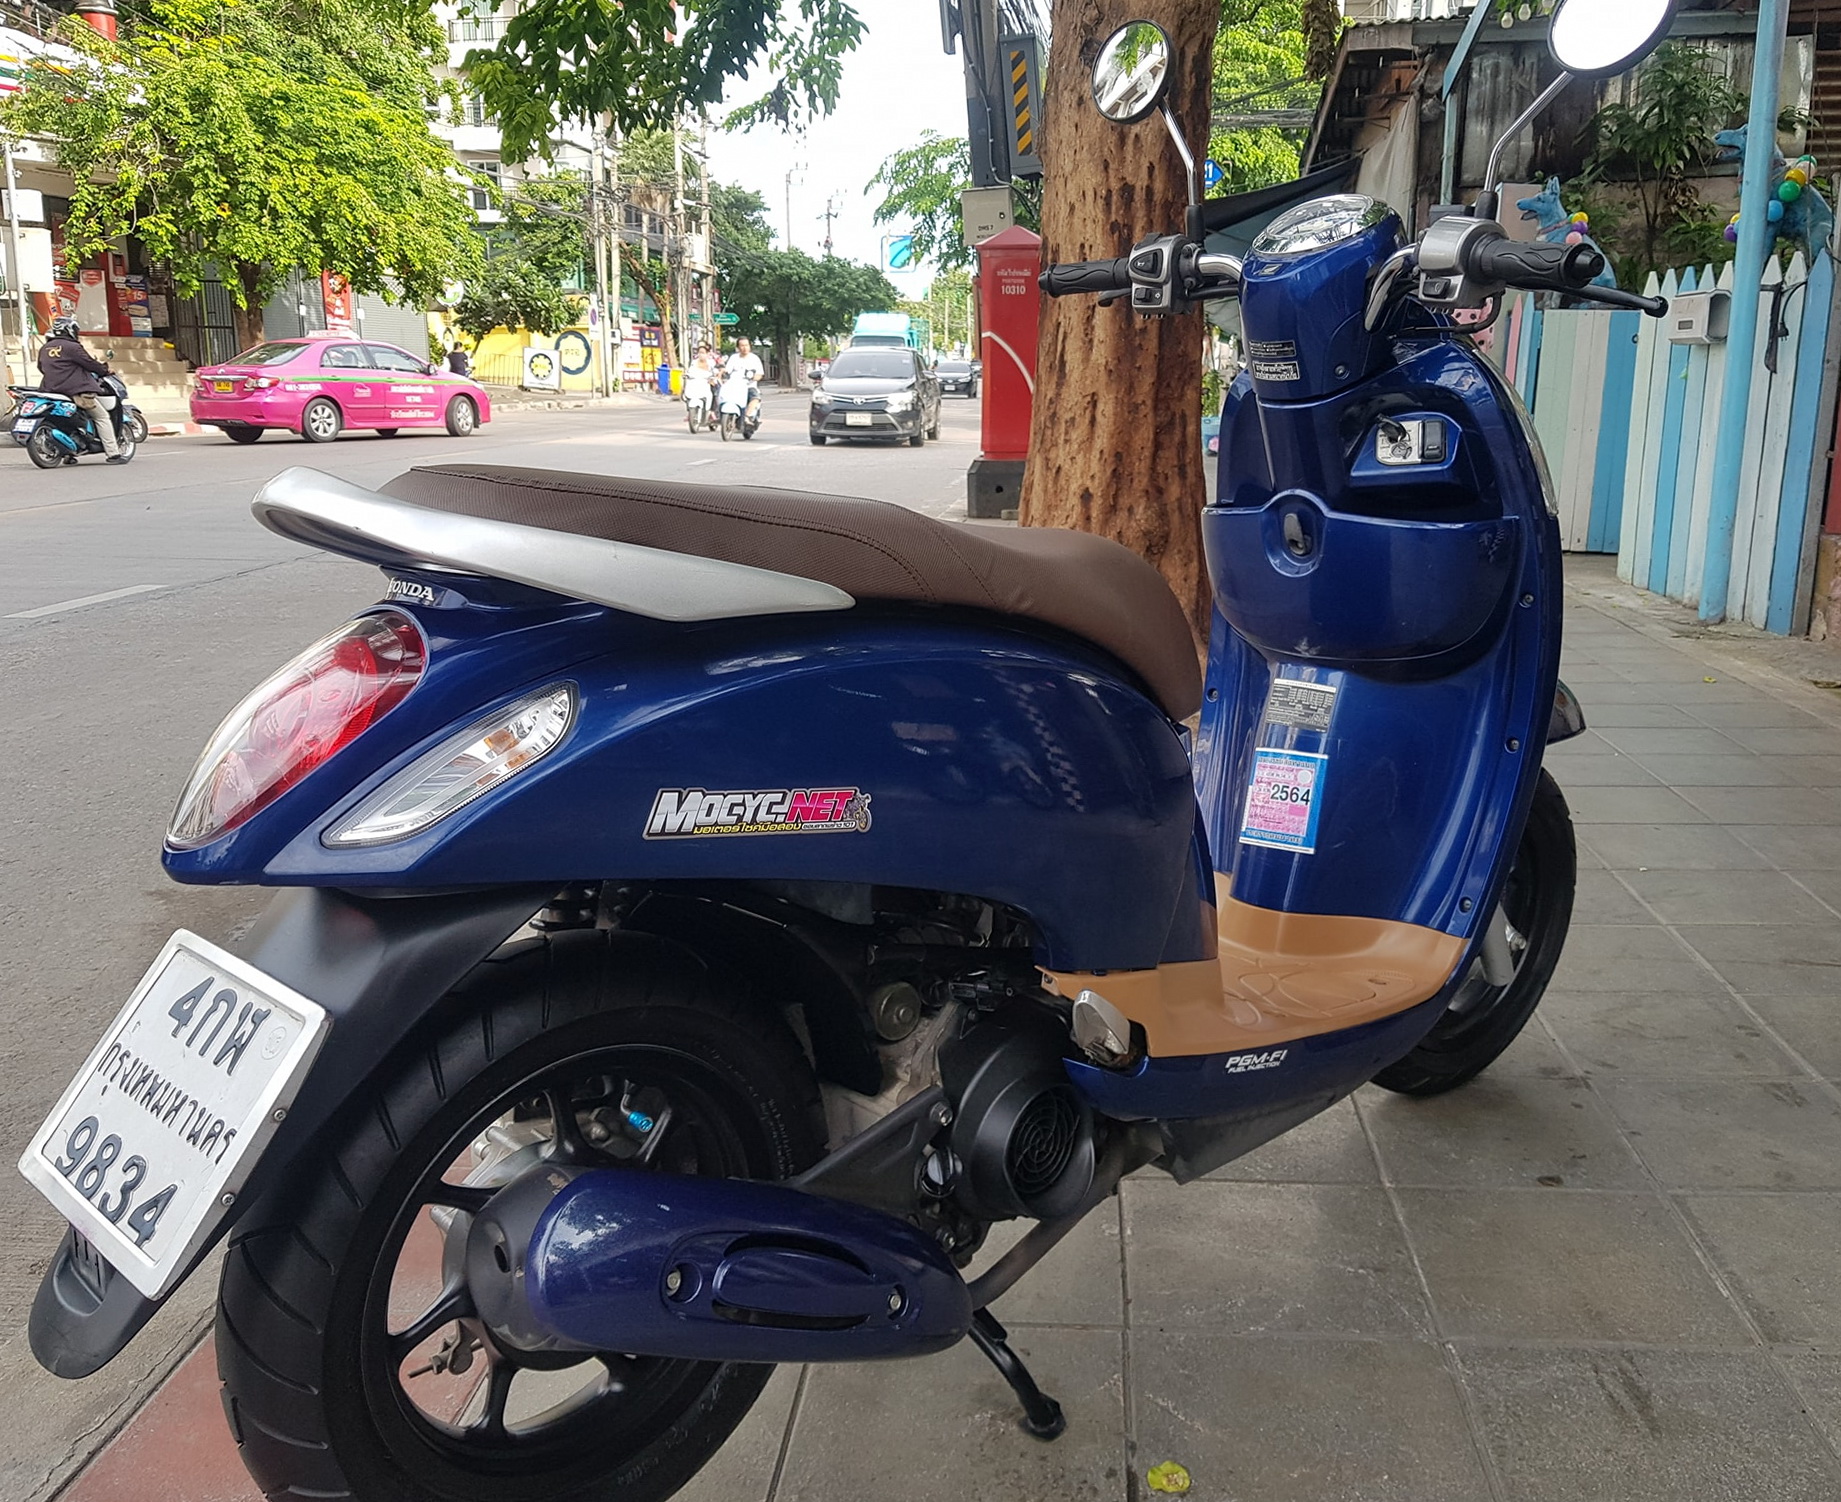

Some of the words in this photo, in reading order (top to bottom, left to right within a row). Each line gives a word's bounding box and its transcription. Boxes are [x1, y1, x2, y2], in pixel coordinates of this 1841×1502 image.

[1002, 285, 1026, 294] 10310
[1271, 784, 1310, 805] 2564
[97, 1042, 237, 1165] กรุงเทพมหานคร
[55, 1116, 178, 1248] 9834
